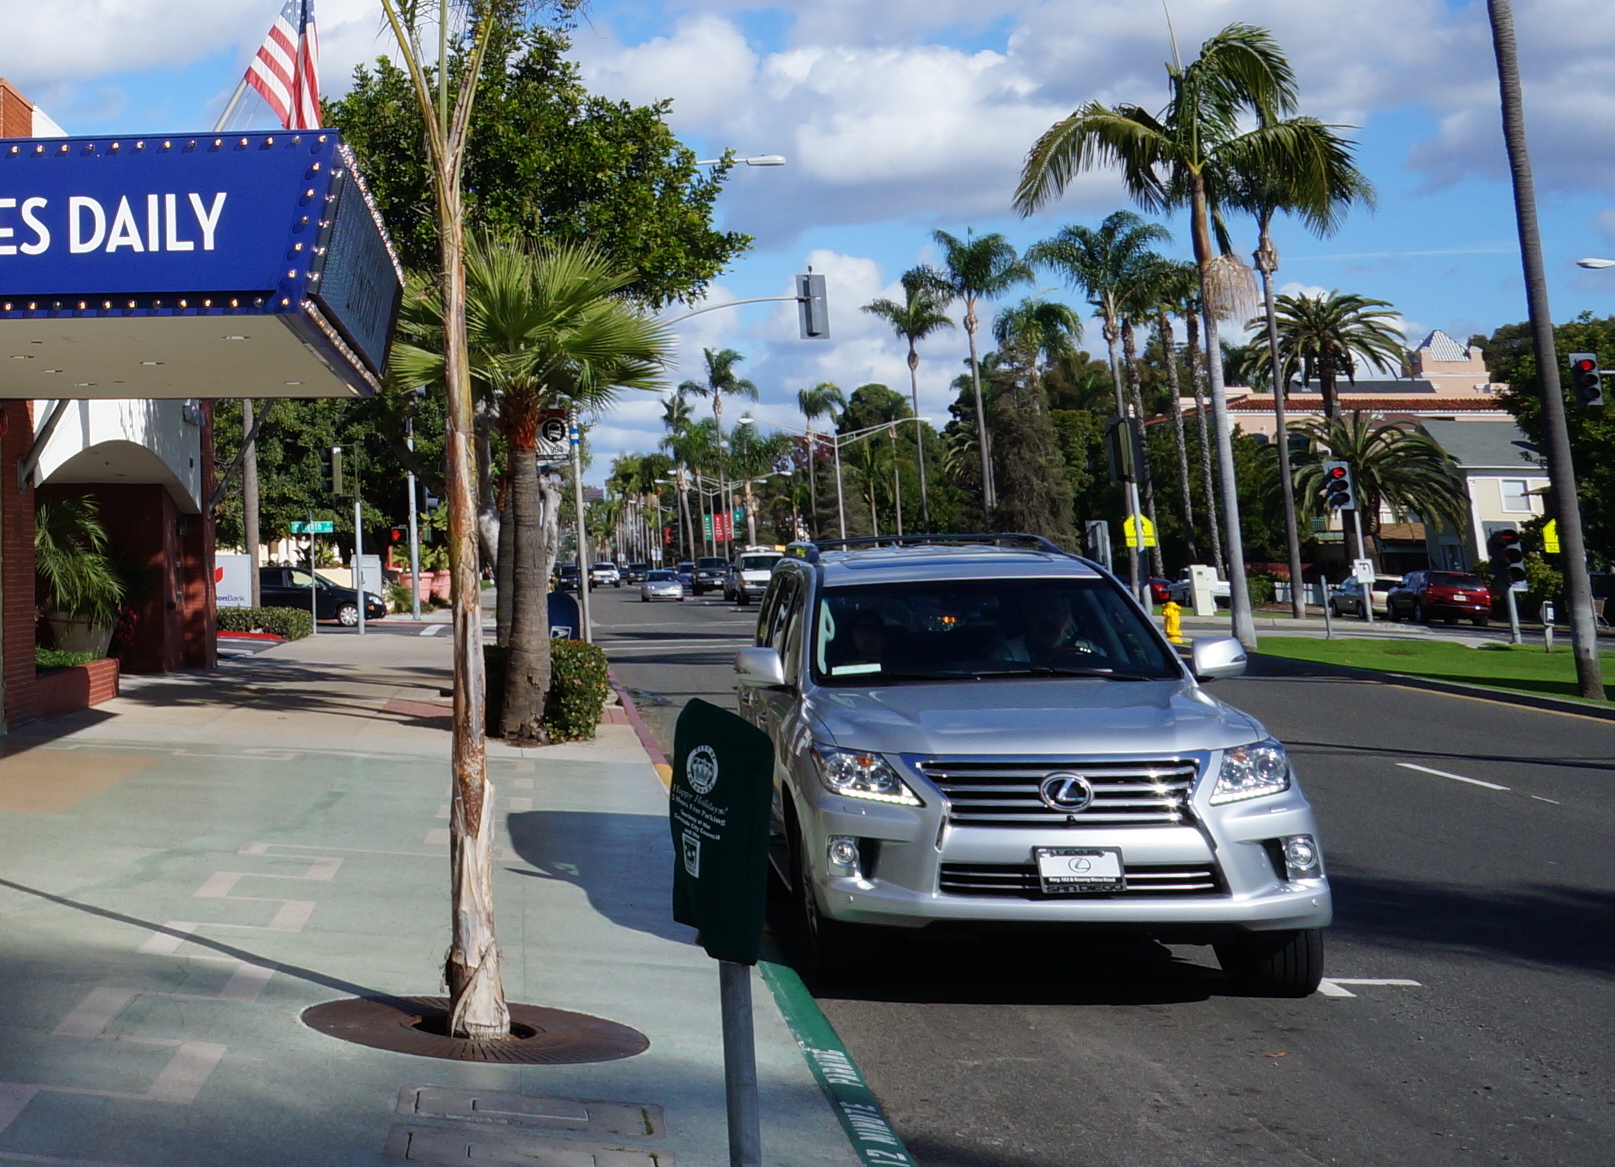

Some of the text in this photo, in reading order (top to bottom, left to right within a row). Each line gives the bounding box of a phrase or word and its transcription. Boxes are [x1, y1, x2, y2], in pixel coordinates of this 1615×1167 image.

[68, 191, 228, 255] DAILY
[673, 784, 694, 801] Happy
[701, 809, 726, 827] Parking
[839, 1100, 898, 1146] MINUTE
